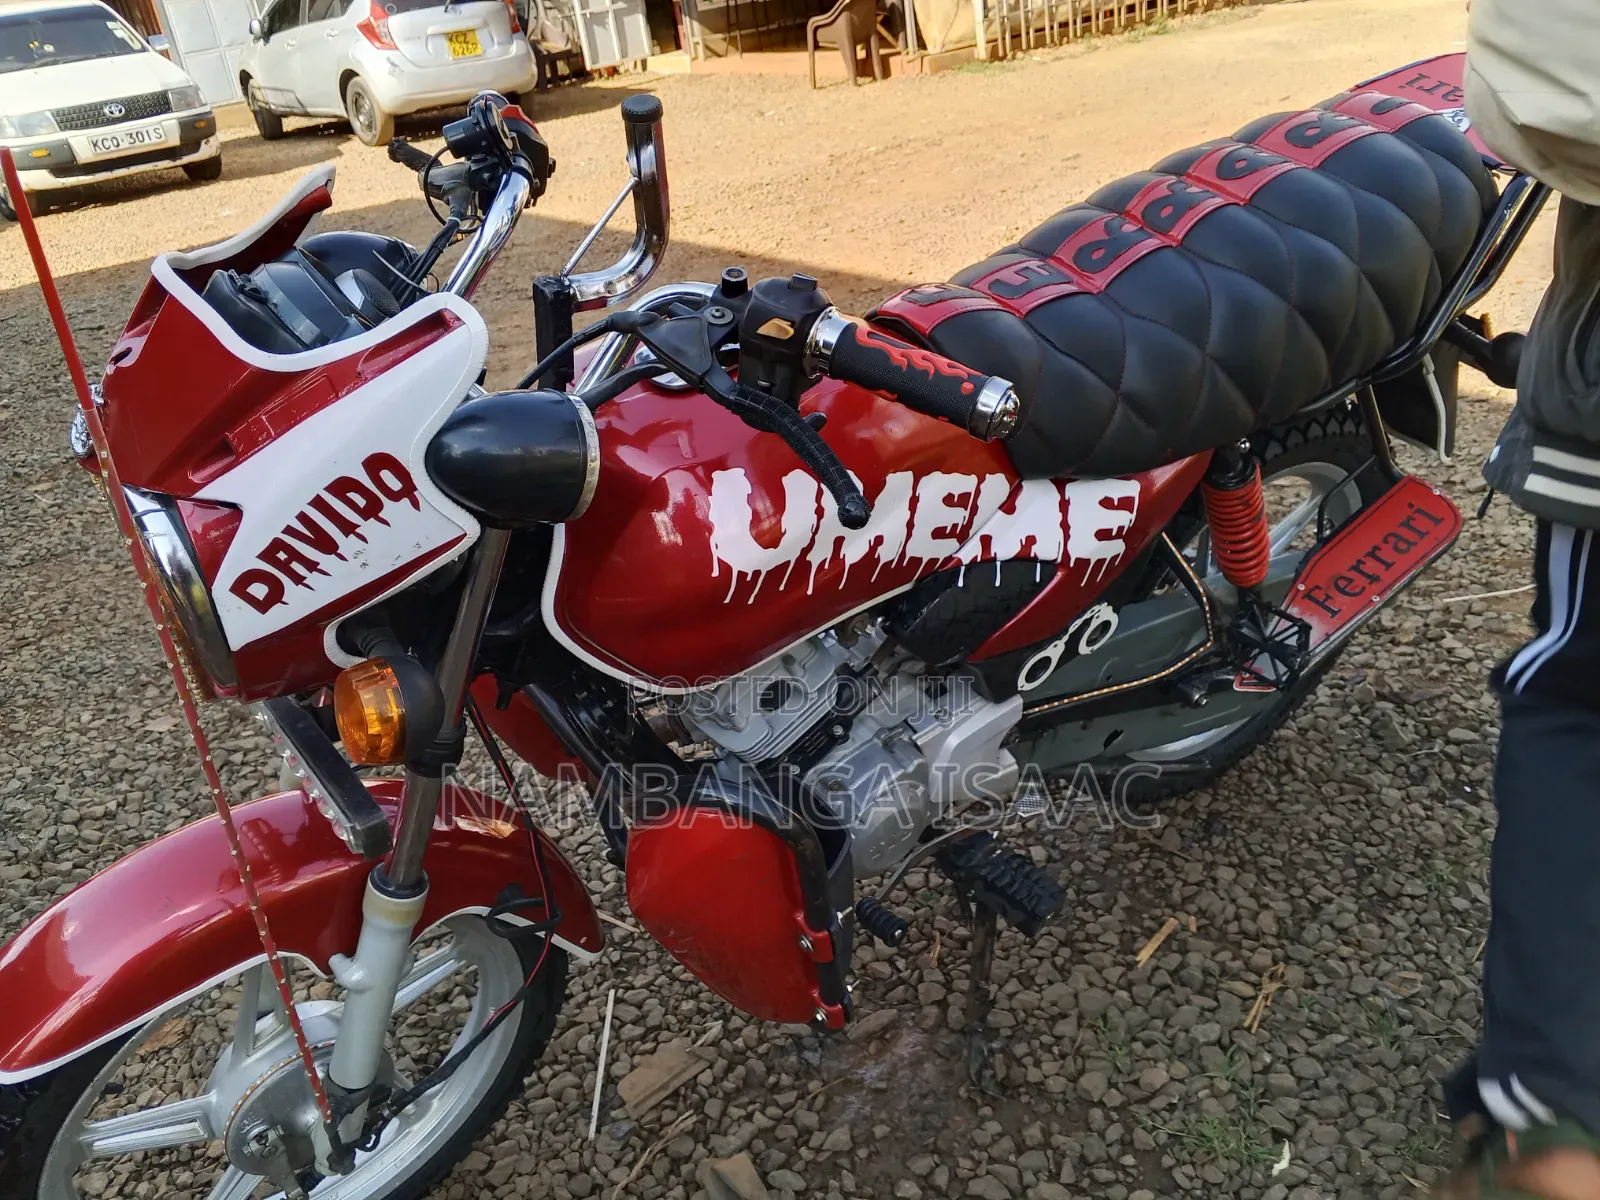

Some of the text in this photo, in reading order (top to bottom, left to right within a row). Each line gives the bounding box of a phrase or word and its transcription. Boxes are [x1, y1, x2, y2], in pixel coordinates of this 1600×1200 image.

[448, 32, 470, 46] KCZ
[452, 42, 478, 56] 626P
[1398, 73, 1464, 103] ari
[708, 467, 1140, 604] UMEME
[1302, 502, 1445, 619] Ferrari
